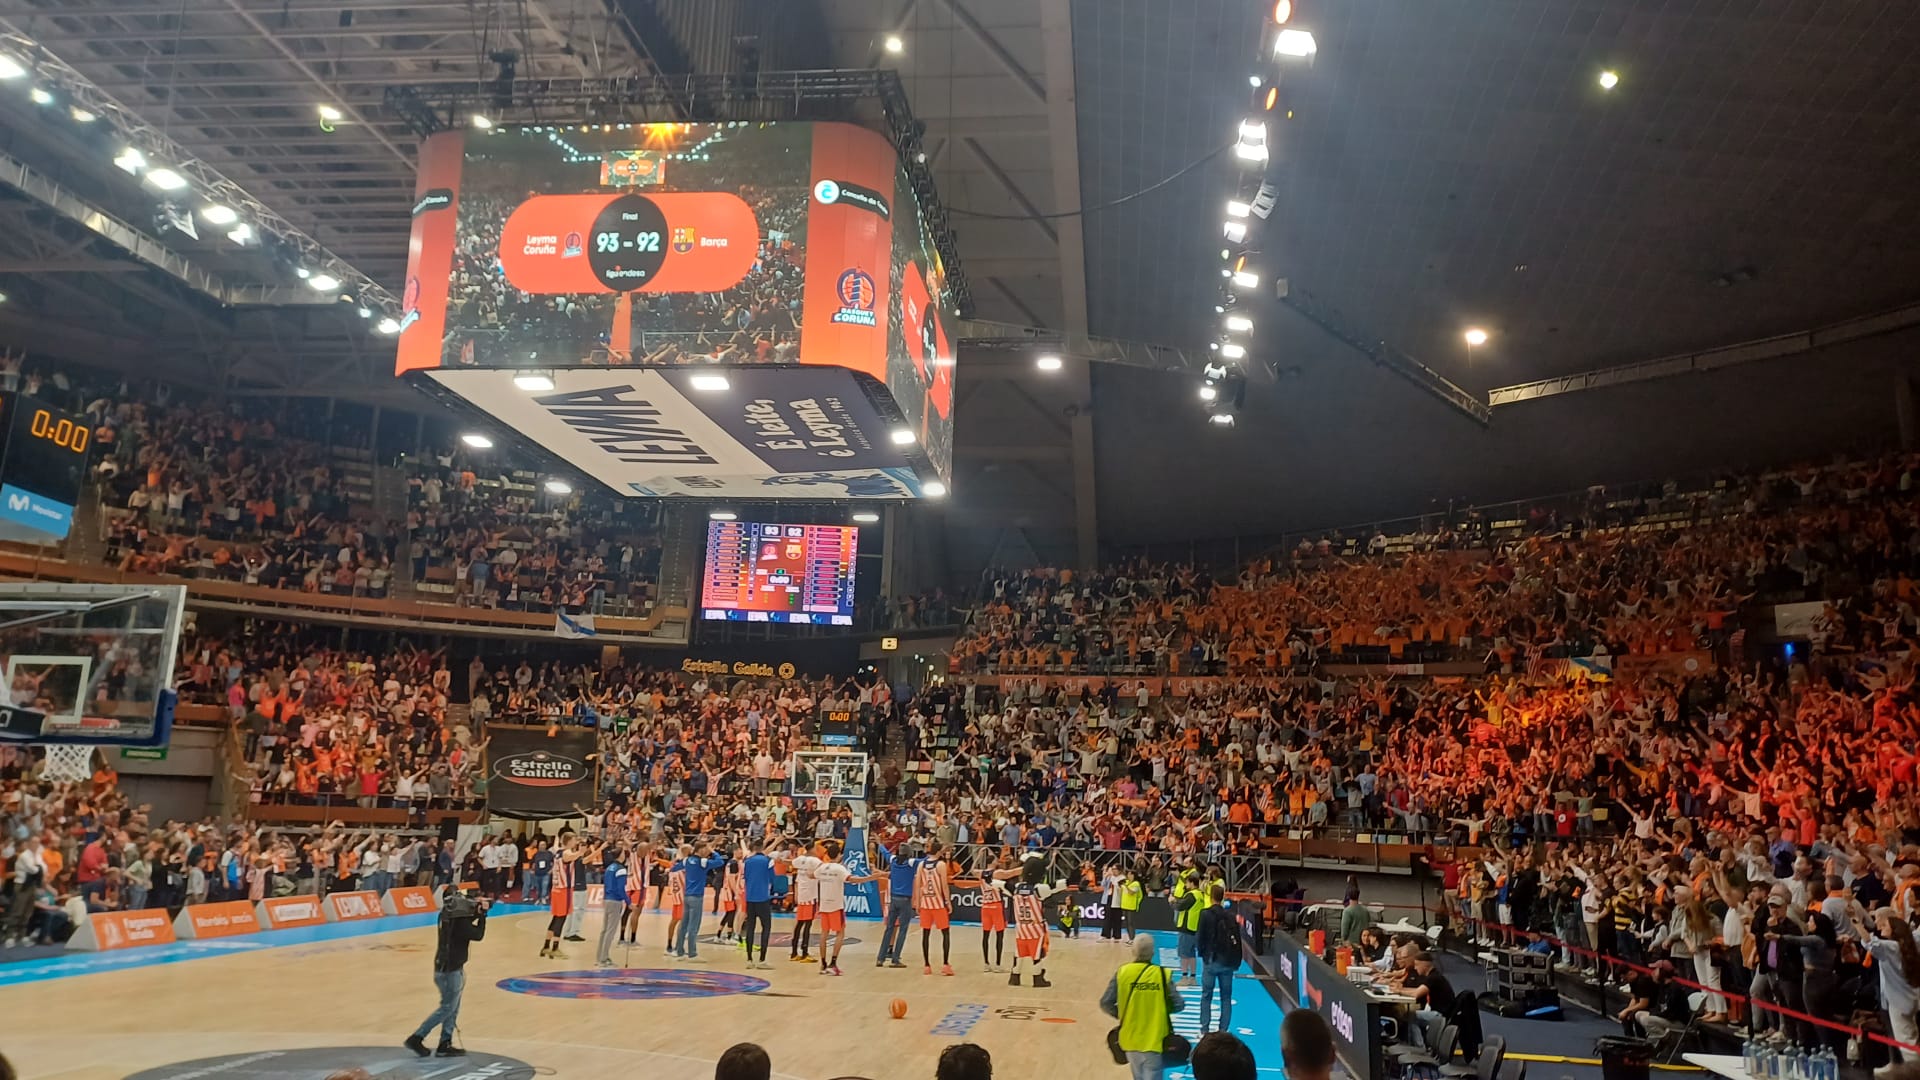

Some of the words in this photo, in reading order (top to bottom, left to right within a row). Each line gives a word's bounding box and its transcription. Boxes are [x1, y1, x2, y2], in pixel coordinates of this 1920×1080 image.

[622, 212, 638, 220] Final
[526, 235, 557, 245] Leyma
[596, 232, 619, 252] 93
[637, 231, 660, 252] 92
[700, 236, 728, 247] Barça
[523, 243, 556, 255] Coruña
[743, 399, 796, 436] leite,
[788, 398, 848, 447] Leyma
[531, 384, 720, 464] LEYMA
[31, 409, 89, 453] 0:00
[816, 449, 856, 457] é
[681, 658, 729, 675] Estrella
[733, 661, 774, 676] Galicia
[829, 712, 850, 721] 0:00
[509, 759, 572, 771] Estrella
[511, 767, 570, 778] Galicia
[843, 896, 871, 914] YMA
